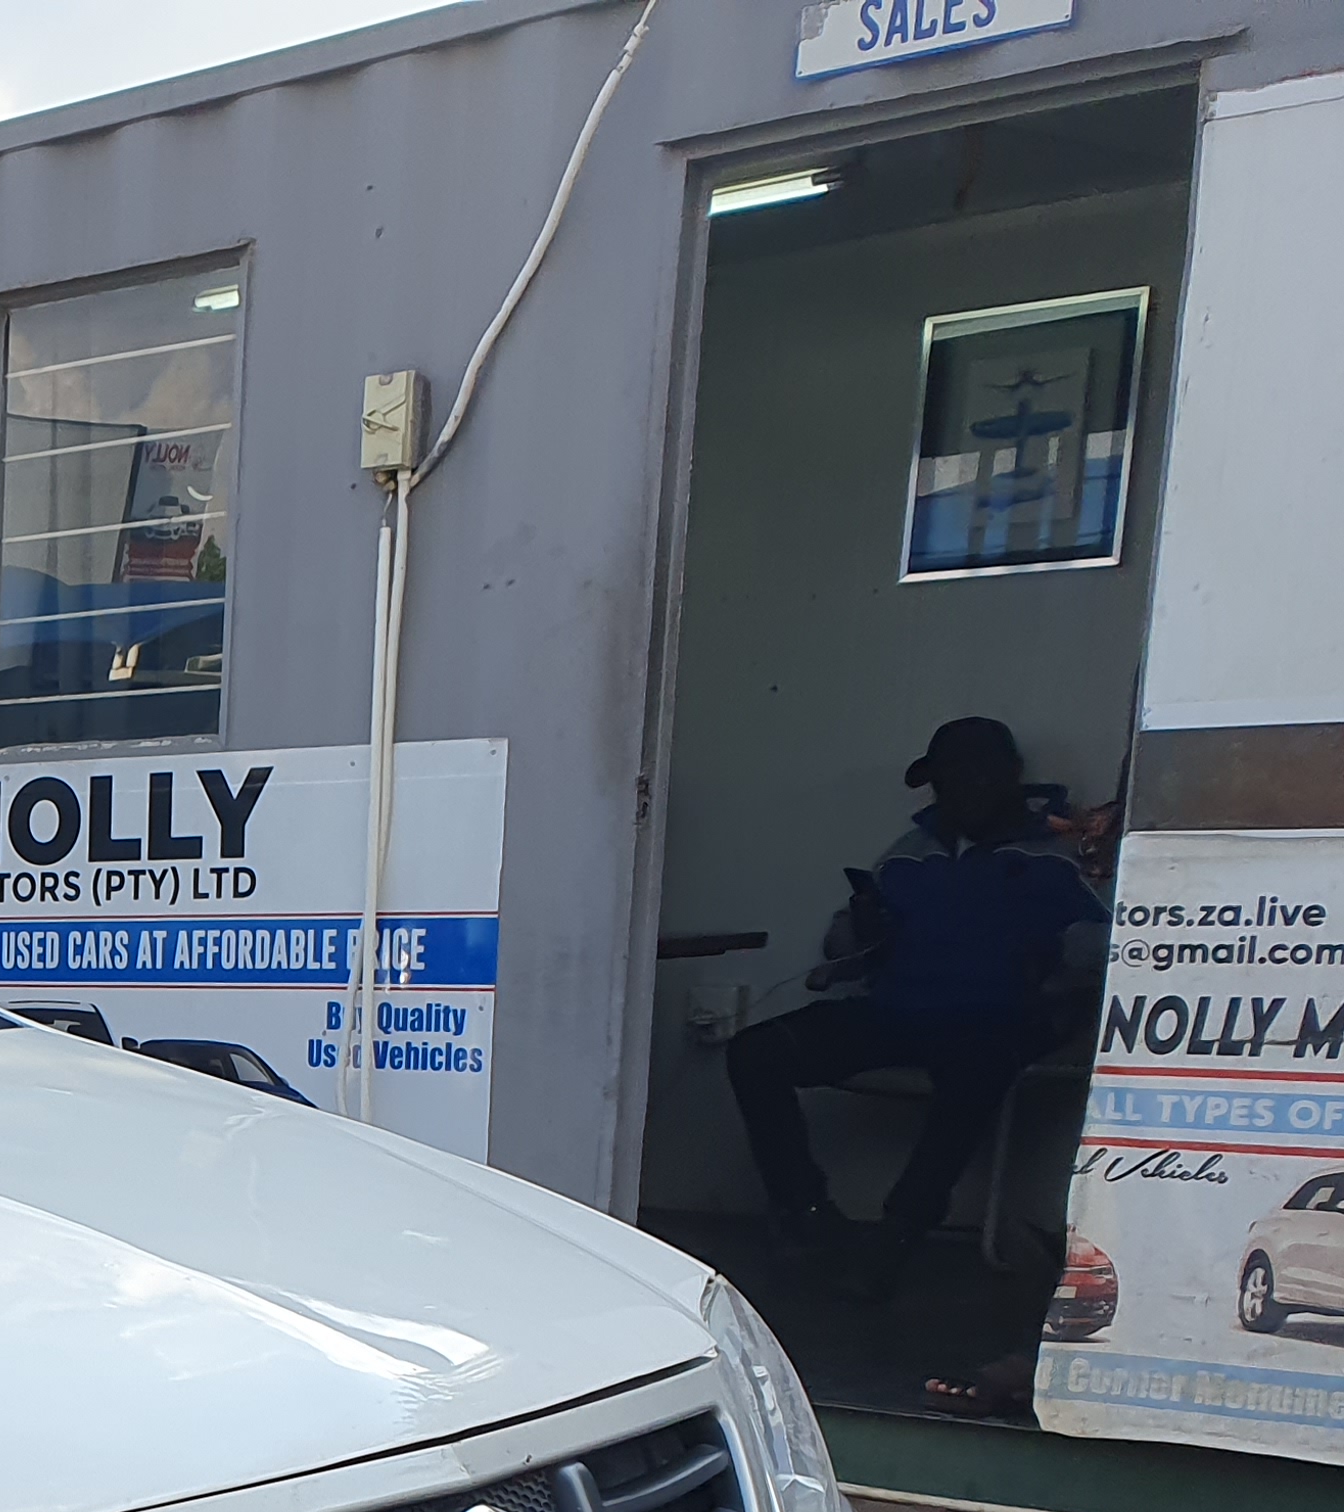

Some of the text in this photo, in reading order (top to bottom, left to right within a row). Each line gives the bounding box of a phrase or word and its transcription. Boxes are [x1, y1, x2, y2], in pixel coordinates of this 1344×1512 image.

[856, 0, 998, 52] SALES
[92, 866, 180, 906] (PTY)
[192, 867, 258, 900] LTD
[1, 930, 60, 970] USED
[67, 930, 129, 970] CARS
[135, 930, 167, 970] AT
[173, 929, 338, 970] AFFORDABLE
[376, 1002, 467, 1036] Quality
[1100, 995, 1288, 1058] NOLLY
[372, 1039, 483, 1073] Vehicles
[1157, 1094, 1275, 1127] TYPES
[1288, 1099, 1344, 1130] OF
[1104, 1147, 1230, 1185] Vehicles
